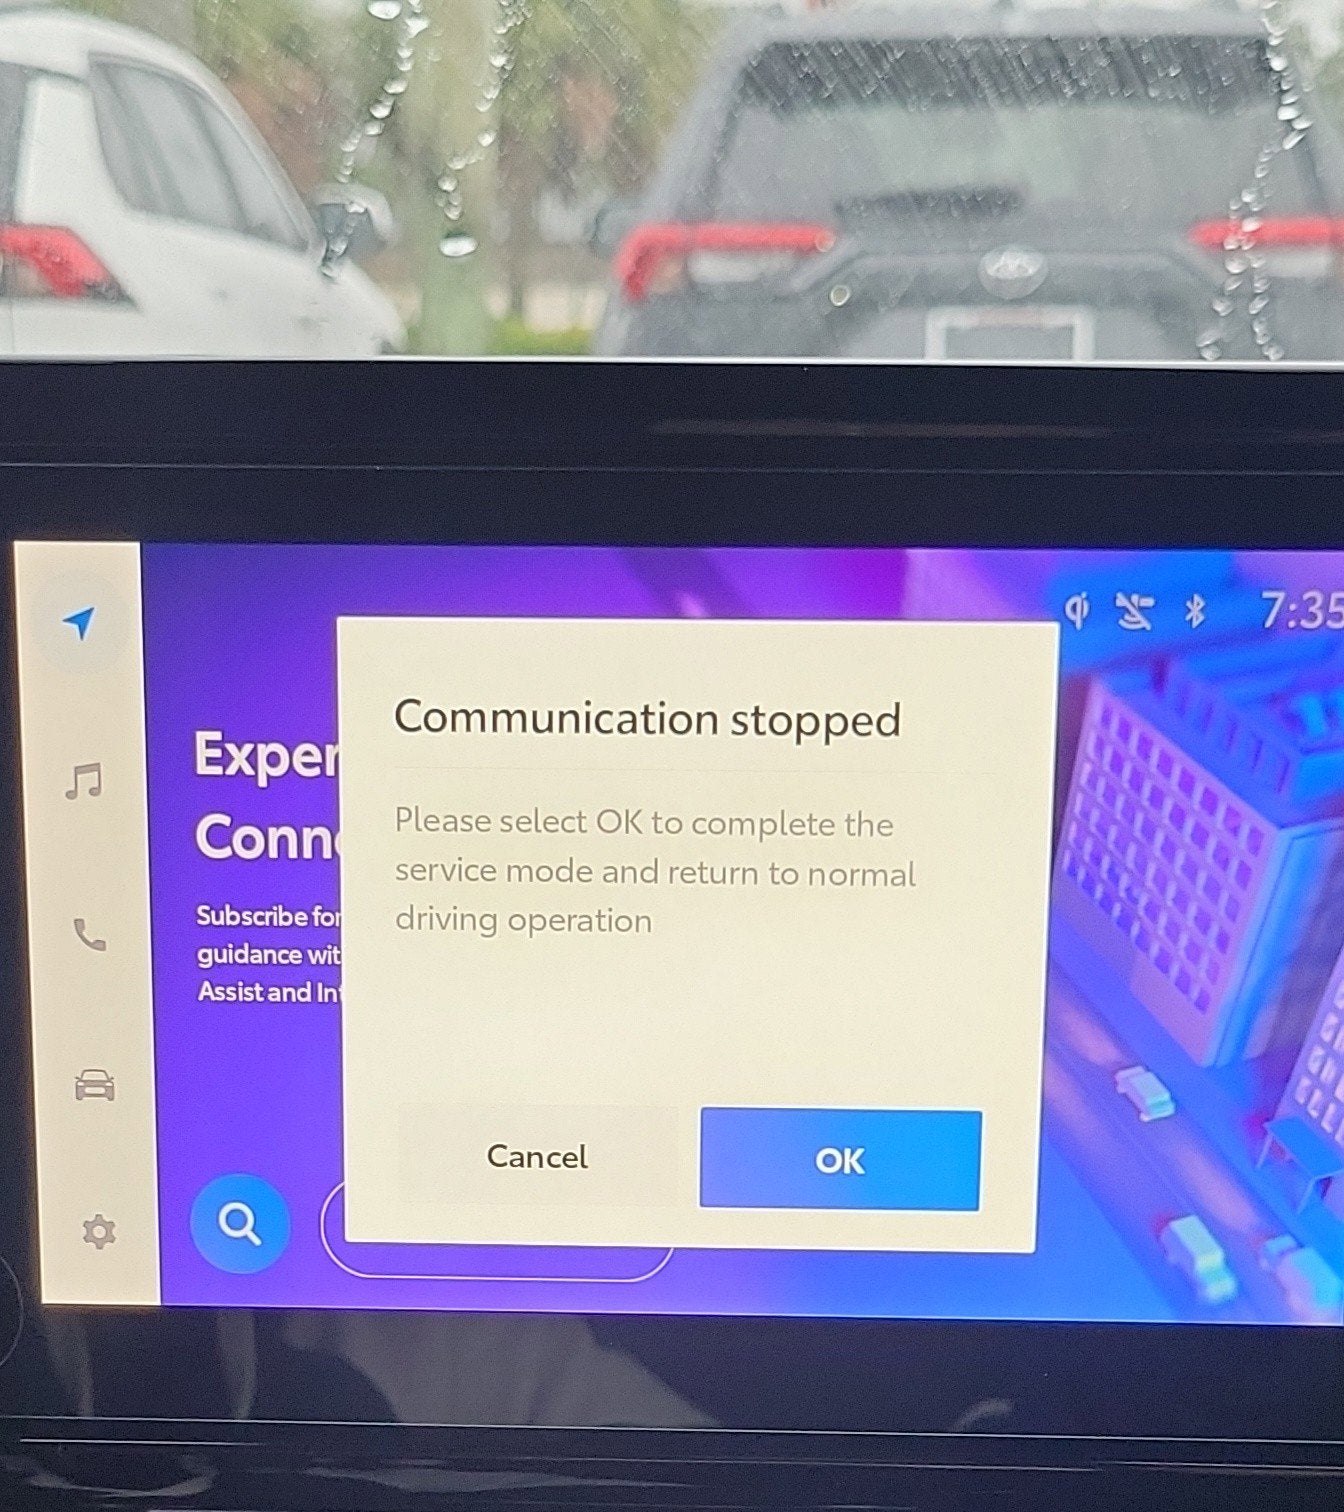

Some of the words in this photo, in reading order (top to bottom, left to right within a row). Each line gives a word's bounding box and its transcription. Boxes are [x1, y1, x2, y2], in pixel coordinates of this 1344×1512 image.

[394, 697, 719, 736] Communication
[730, 701, 901, 746] stopped
[195, 730, 340, 788] Exper
[196, 812, 342, 860] Conn
[395, 804, 492, 833] Please
[500, 806, 588, 834] select
[596, 808, 644, 835] OK
[651, 810, 683, 836] to
[691, 809, 836, 843] complete
[844, 810, 895, 837] the
[395, 856, 497, 882] service
[506, 856, 594, 883] mode
[602, 857, 659, 884] and
[668, 861, 759, 885] return
[769, 861, 799, 885] to
[808, 860, 917, 887] normal
[196, 903, 309, 927] Subscribe
[311, 904, 342, 927] for
[395, 903, 498, 939] driving
[507, 906, 653, 939] operation
[197, 942, 304, 969] guidance
[198, 980, 264, 1002] Assist
[266, 980, 312, 1003] and
[487, 1142, 589, 1171] Cancel
[815, 1146, 866, 1175] OK
